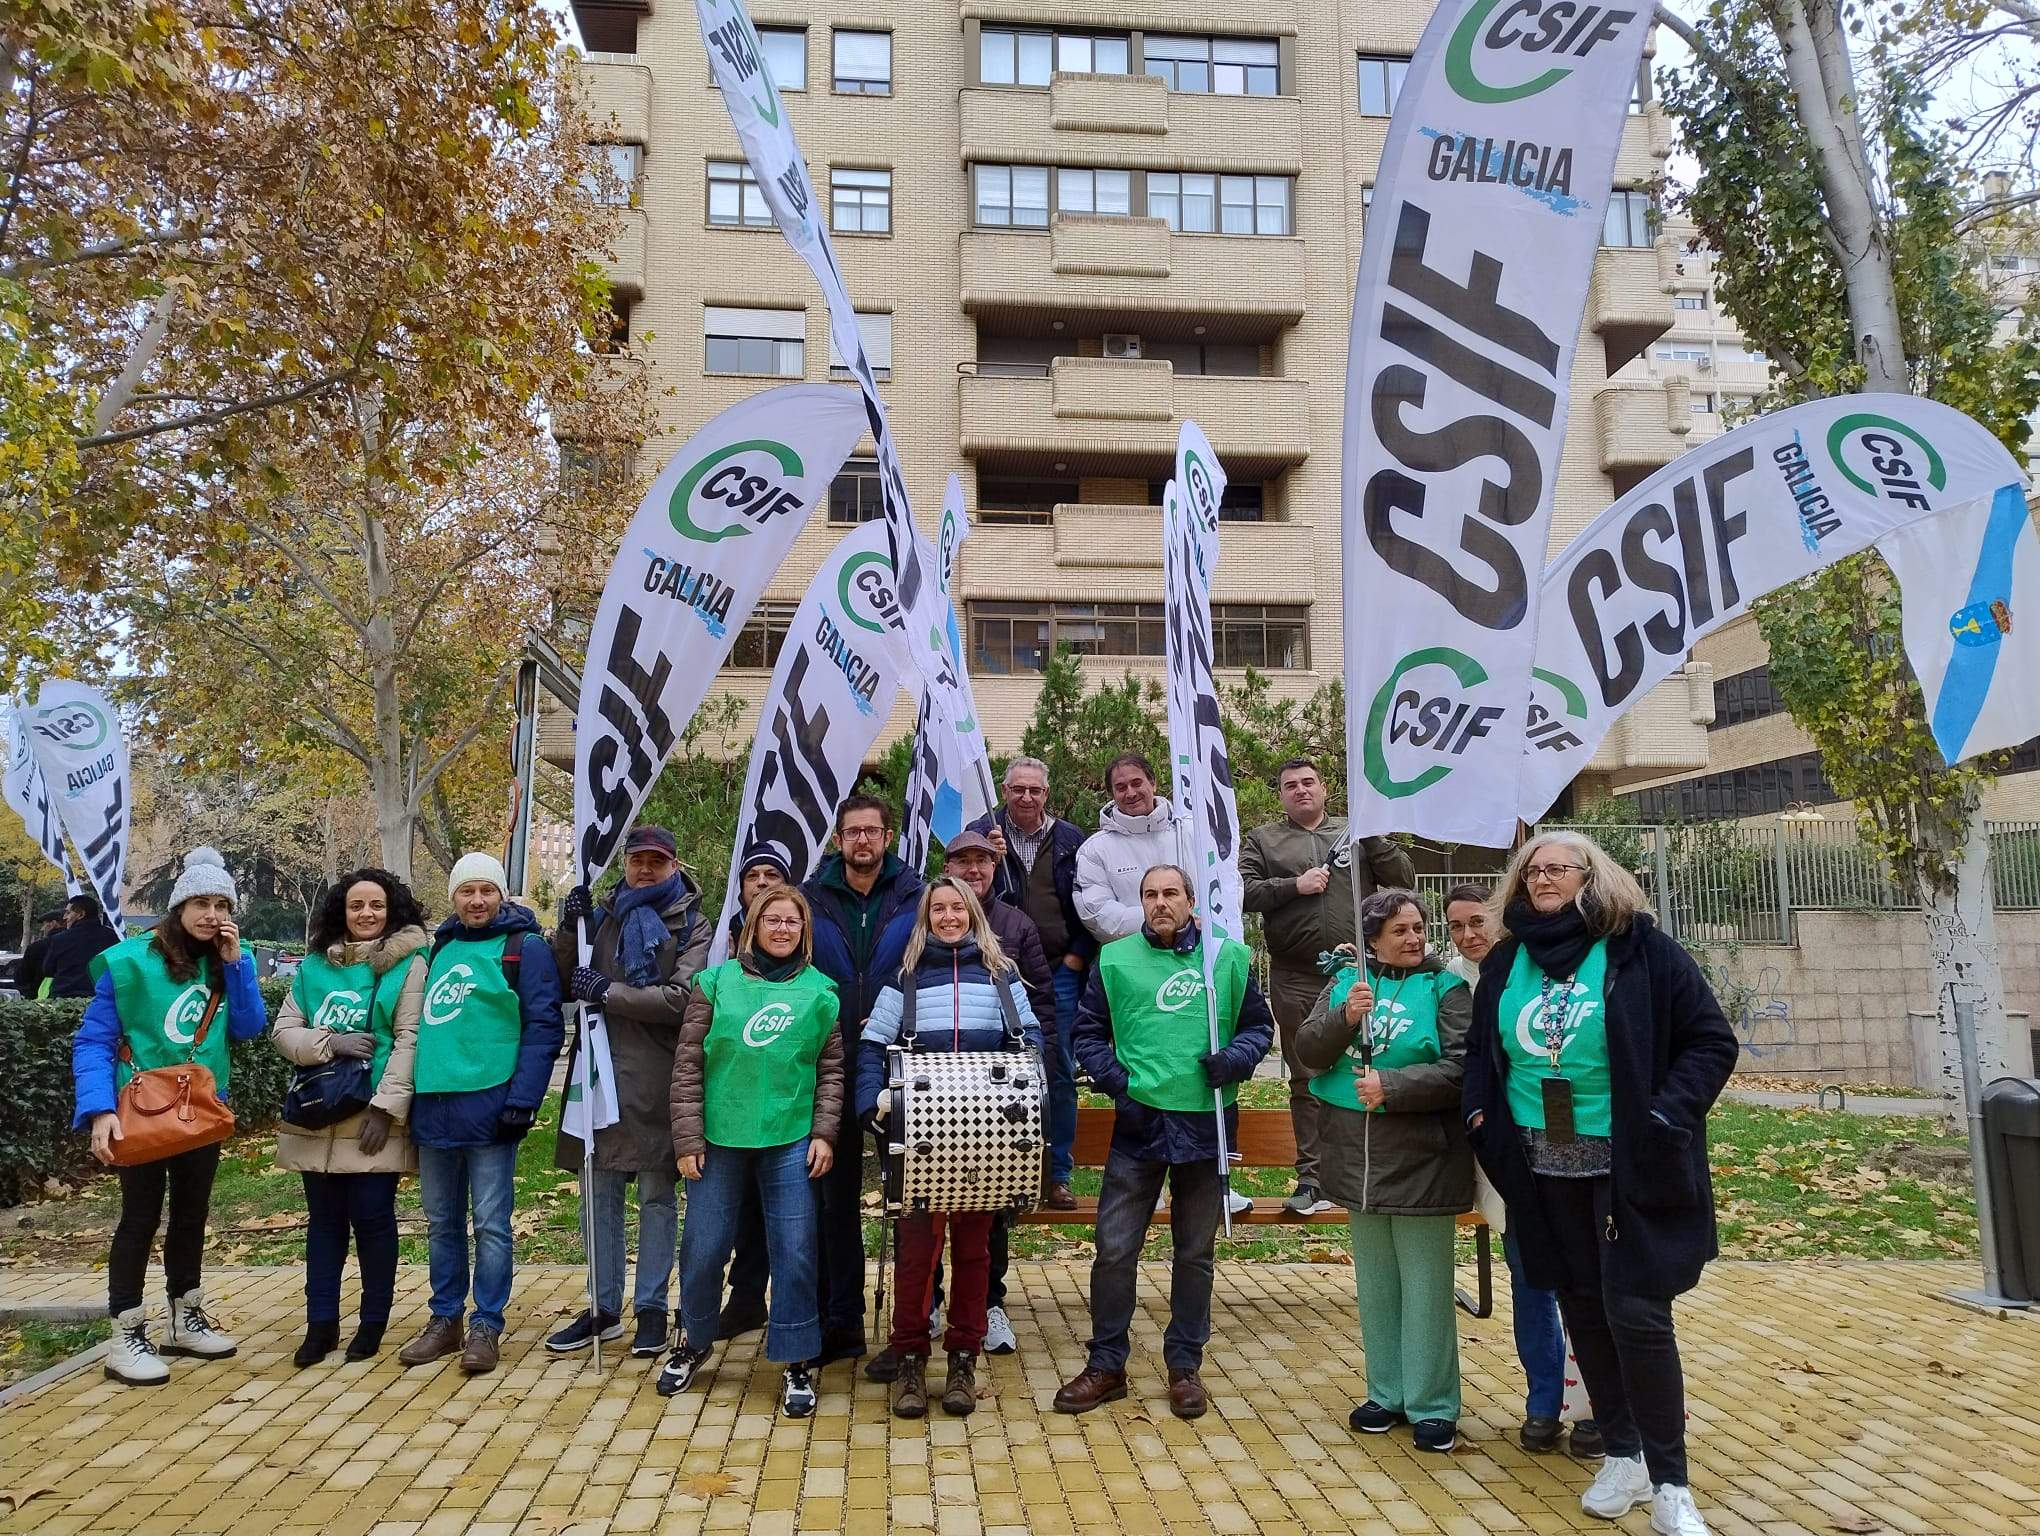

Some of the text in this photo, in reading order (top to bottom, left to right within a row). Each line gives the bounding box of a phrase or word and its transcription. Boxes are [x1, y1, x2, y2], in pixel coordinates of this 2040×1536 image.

[1484, 0, 1637, 57] CSIF
[1427, 134, 1574, 197] GALICIA
[1364, 200, 1560, 631] CSIF
[700, 466, 803, 525] CSIF
[1772, 442, 1843, 541] GALICIA
[1861, 432, 1931, 512] CSIF
[643, 556, 736, 624] GALICIA
[1567, 446, 1754, 708] CSIF
[814, 616, 881, 701] GALICIA
[1390, 690, 1506, 755] CSIF
[1525, 691, 1584, 753] SIF
[179, 1000, 226, 1022] CSF
[322, 1004, 368, 1026] CSIF
[433, 983, 478, 1005] CSIF
[1166, 980, 1205, 997] CSIF
[753, 1014, 796, 1032] CSIF
[1371, 1015, 1415, 1040] SIF
